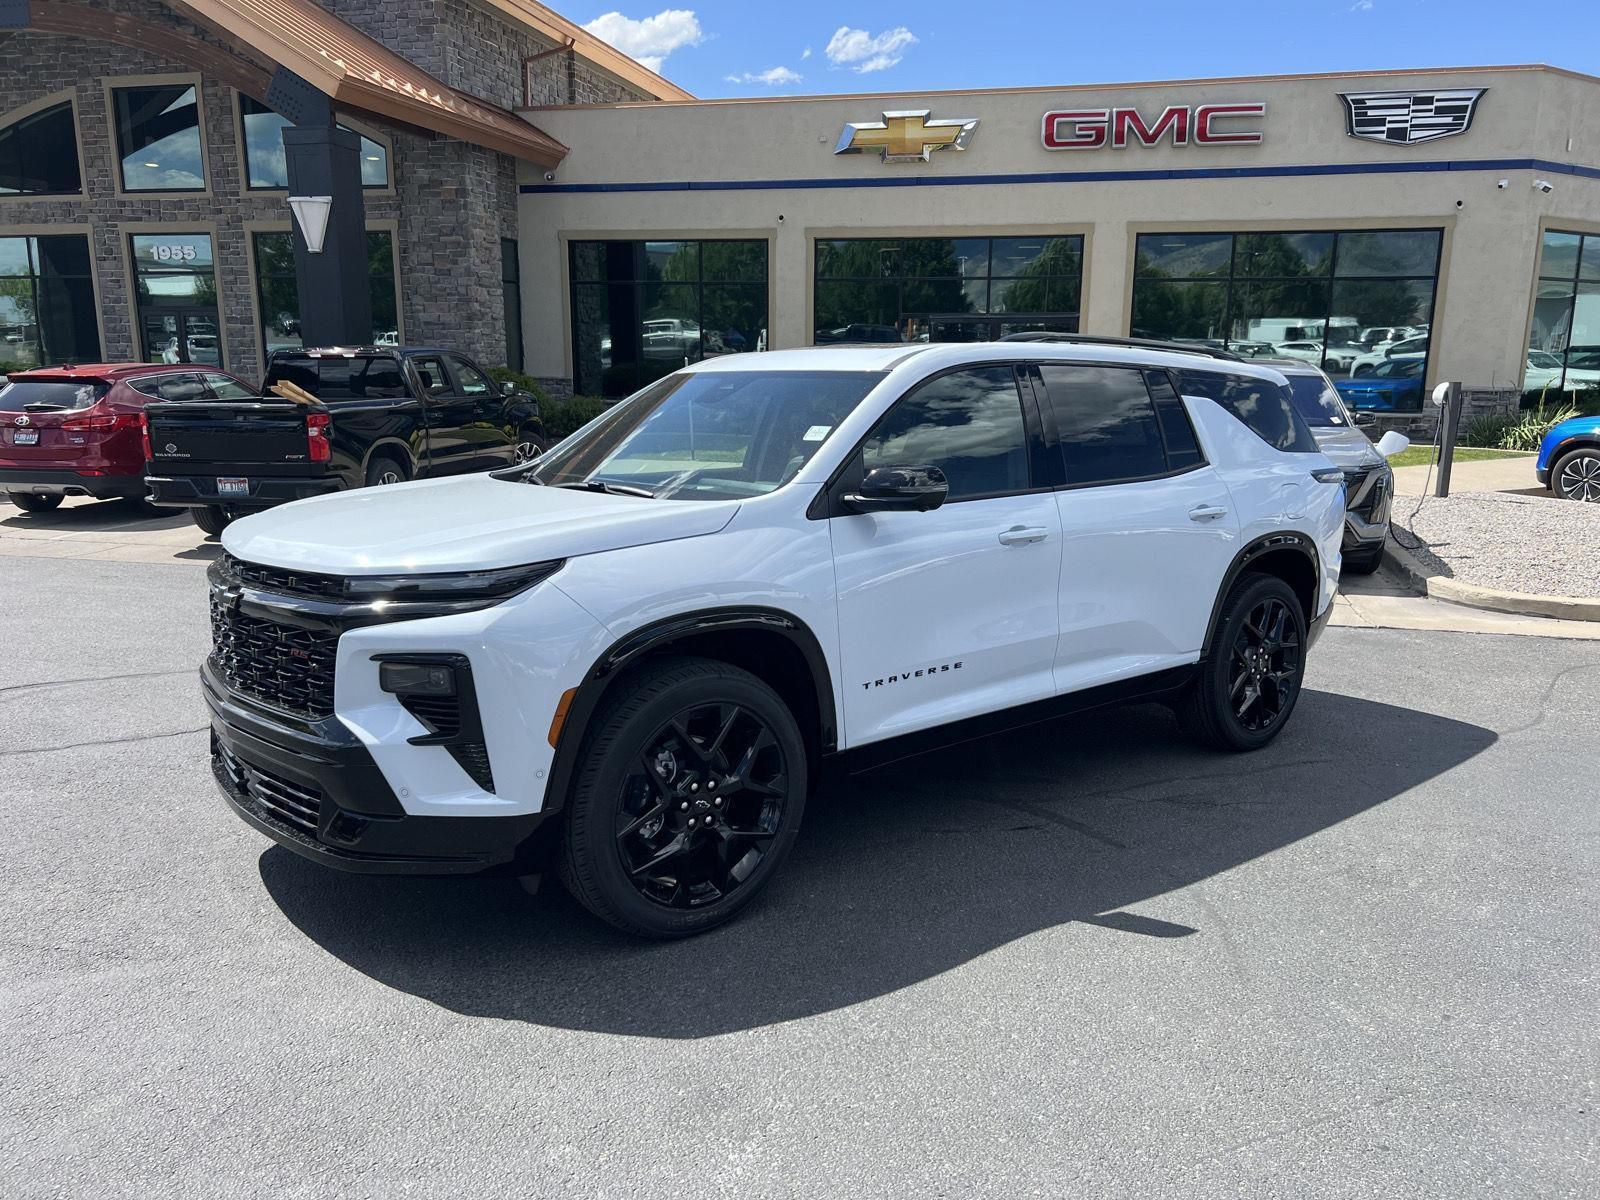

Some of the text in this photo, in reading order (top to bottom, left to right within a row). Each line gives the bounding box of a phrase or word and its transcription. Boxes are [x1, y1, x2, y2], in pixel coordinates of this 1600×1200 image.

[1041, 102, 1266, 150] GMC
[150, 245, 196, 260] 1955
[862, 661, 963, 690] TRAVERSE
